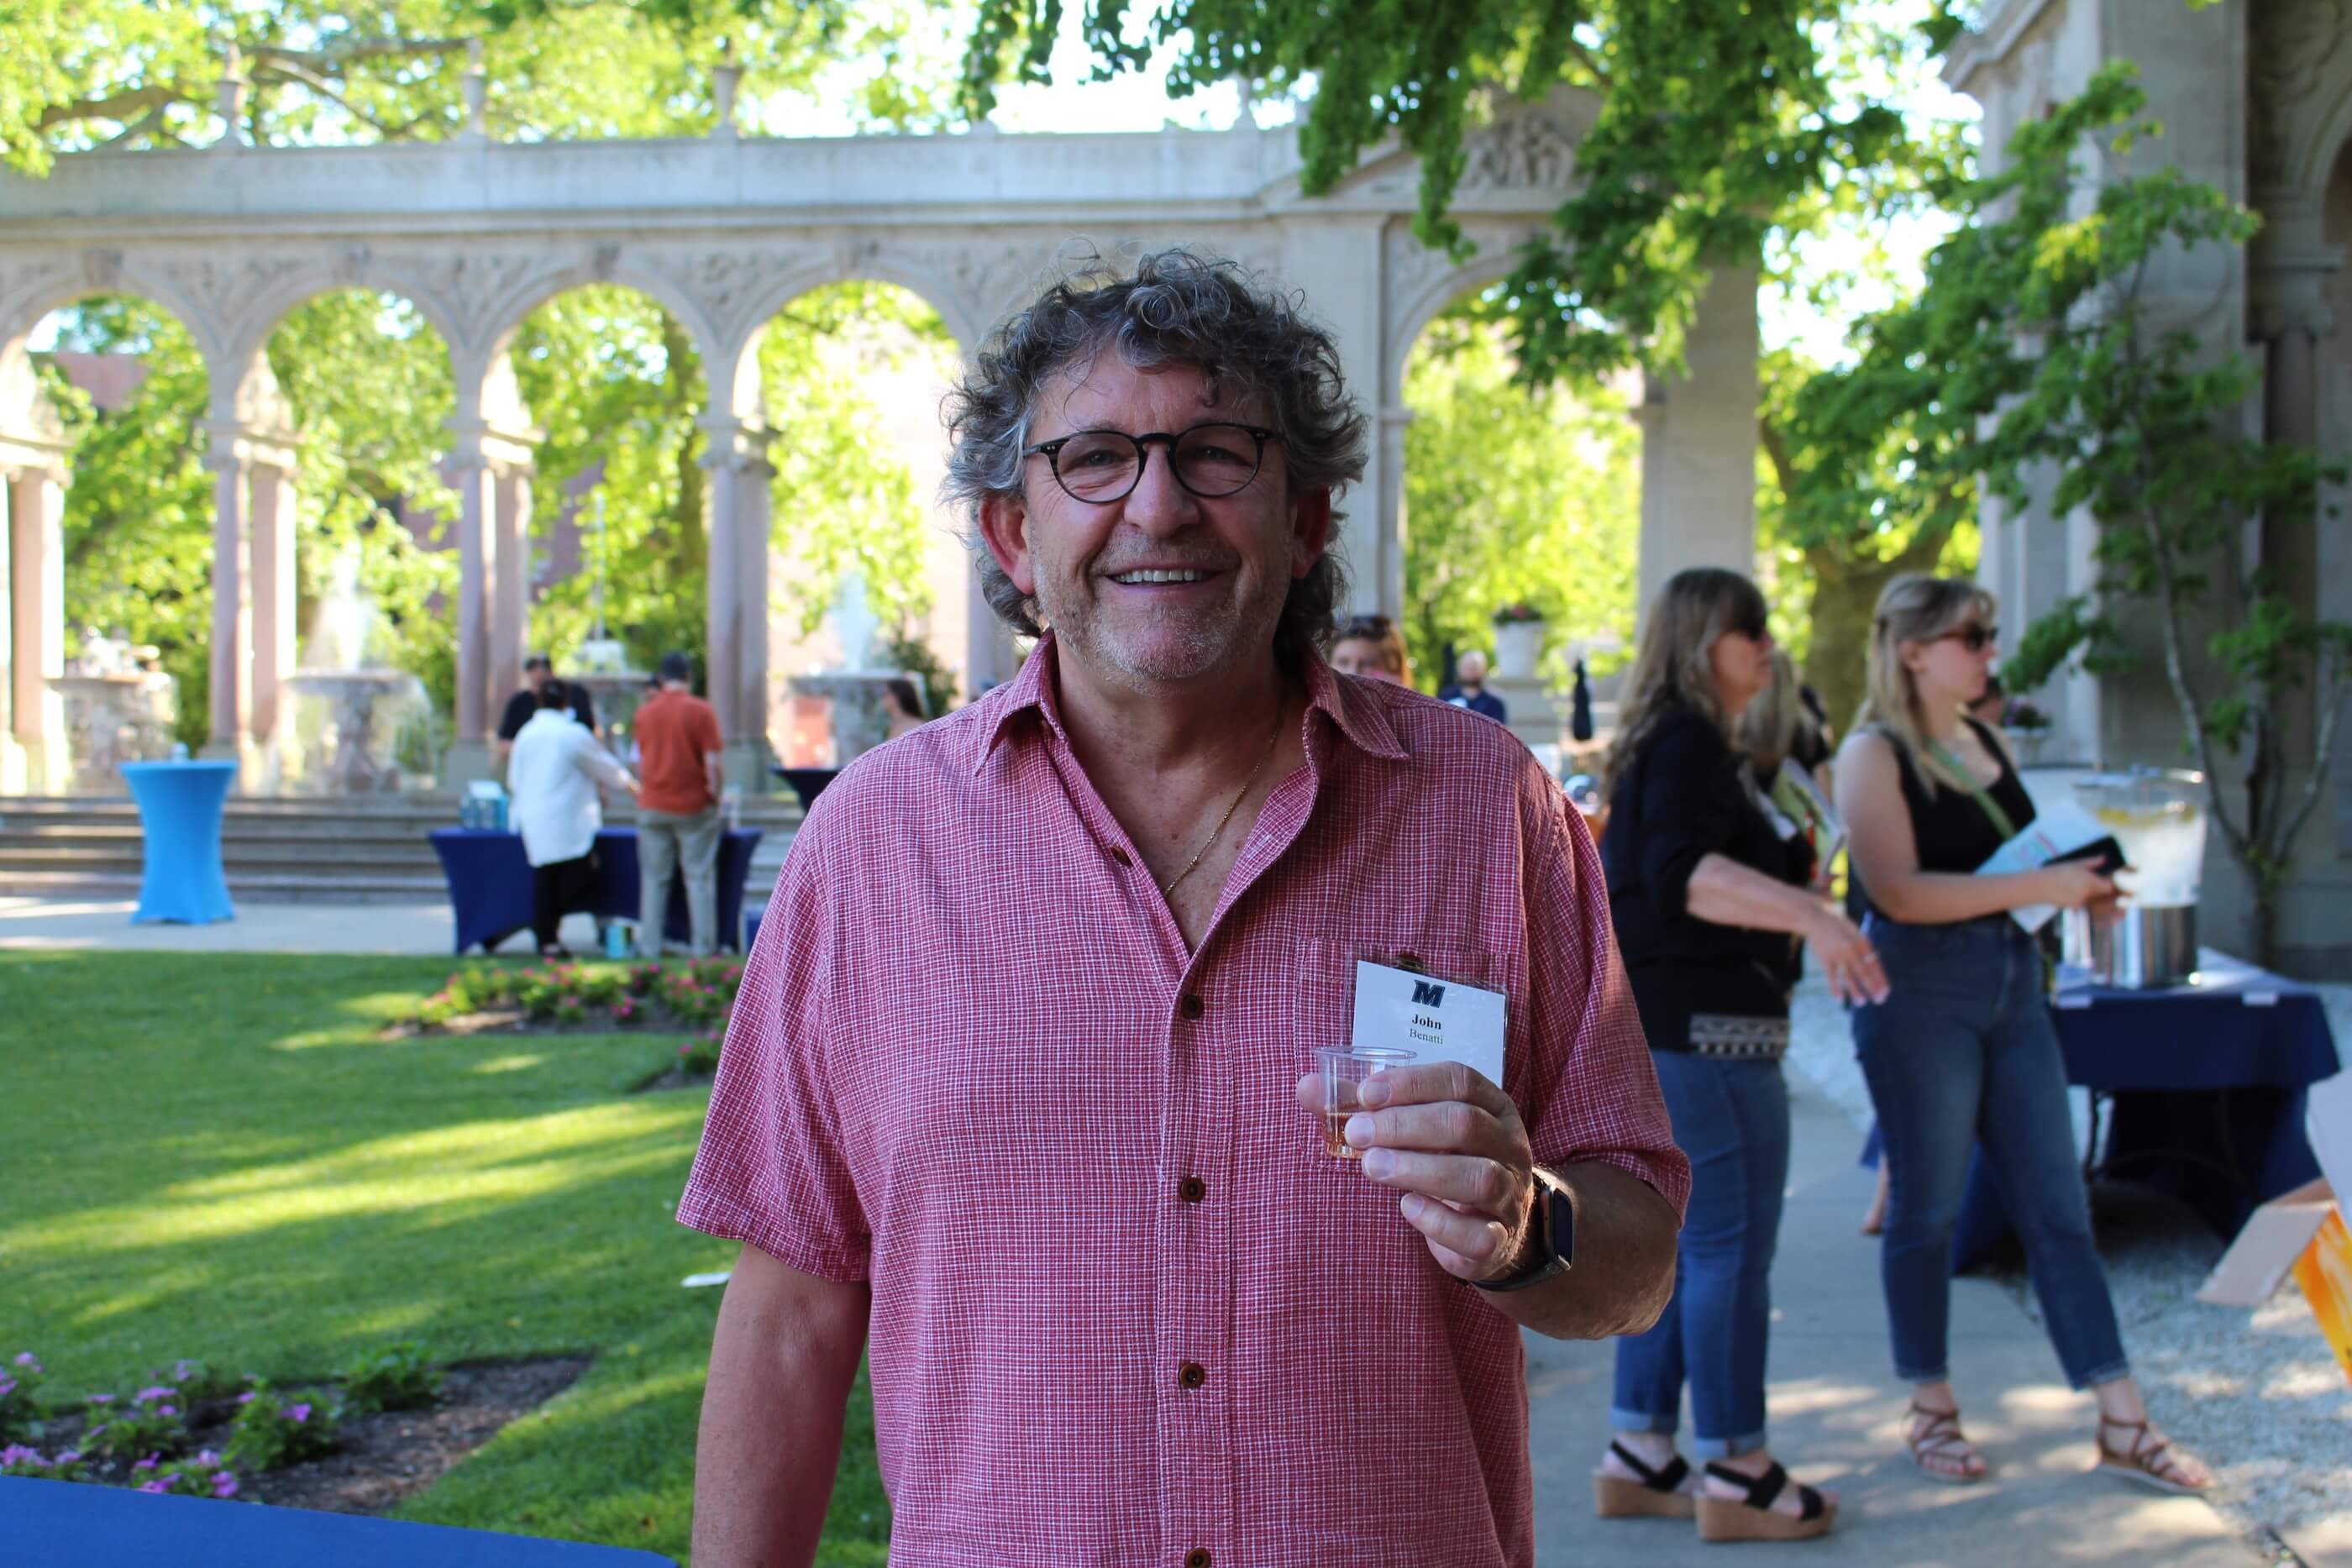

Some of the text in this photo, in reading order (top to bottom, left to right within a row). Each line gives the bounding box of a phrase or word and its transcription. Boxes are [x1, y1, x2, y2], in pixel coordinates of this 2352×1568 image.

[1411, 979, 1445, 1008] M
[1412, 1014, 1441, 1030] John
[1410, 1028, 1443, 1045] Benatti
